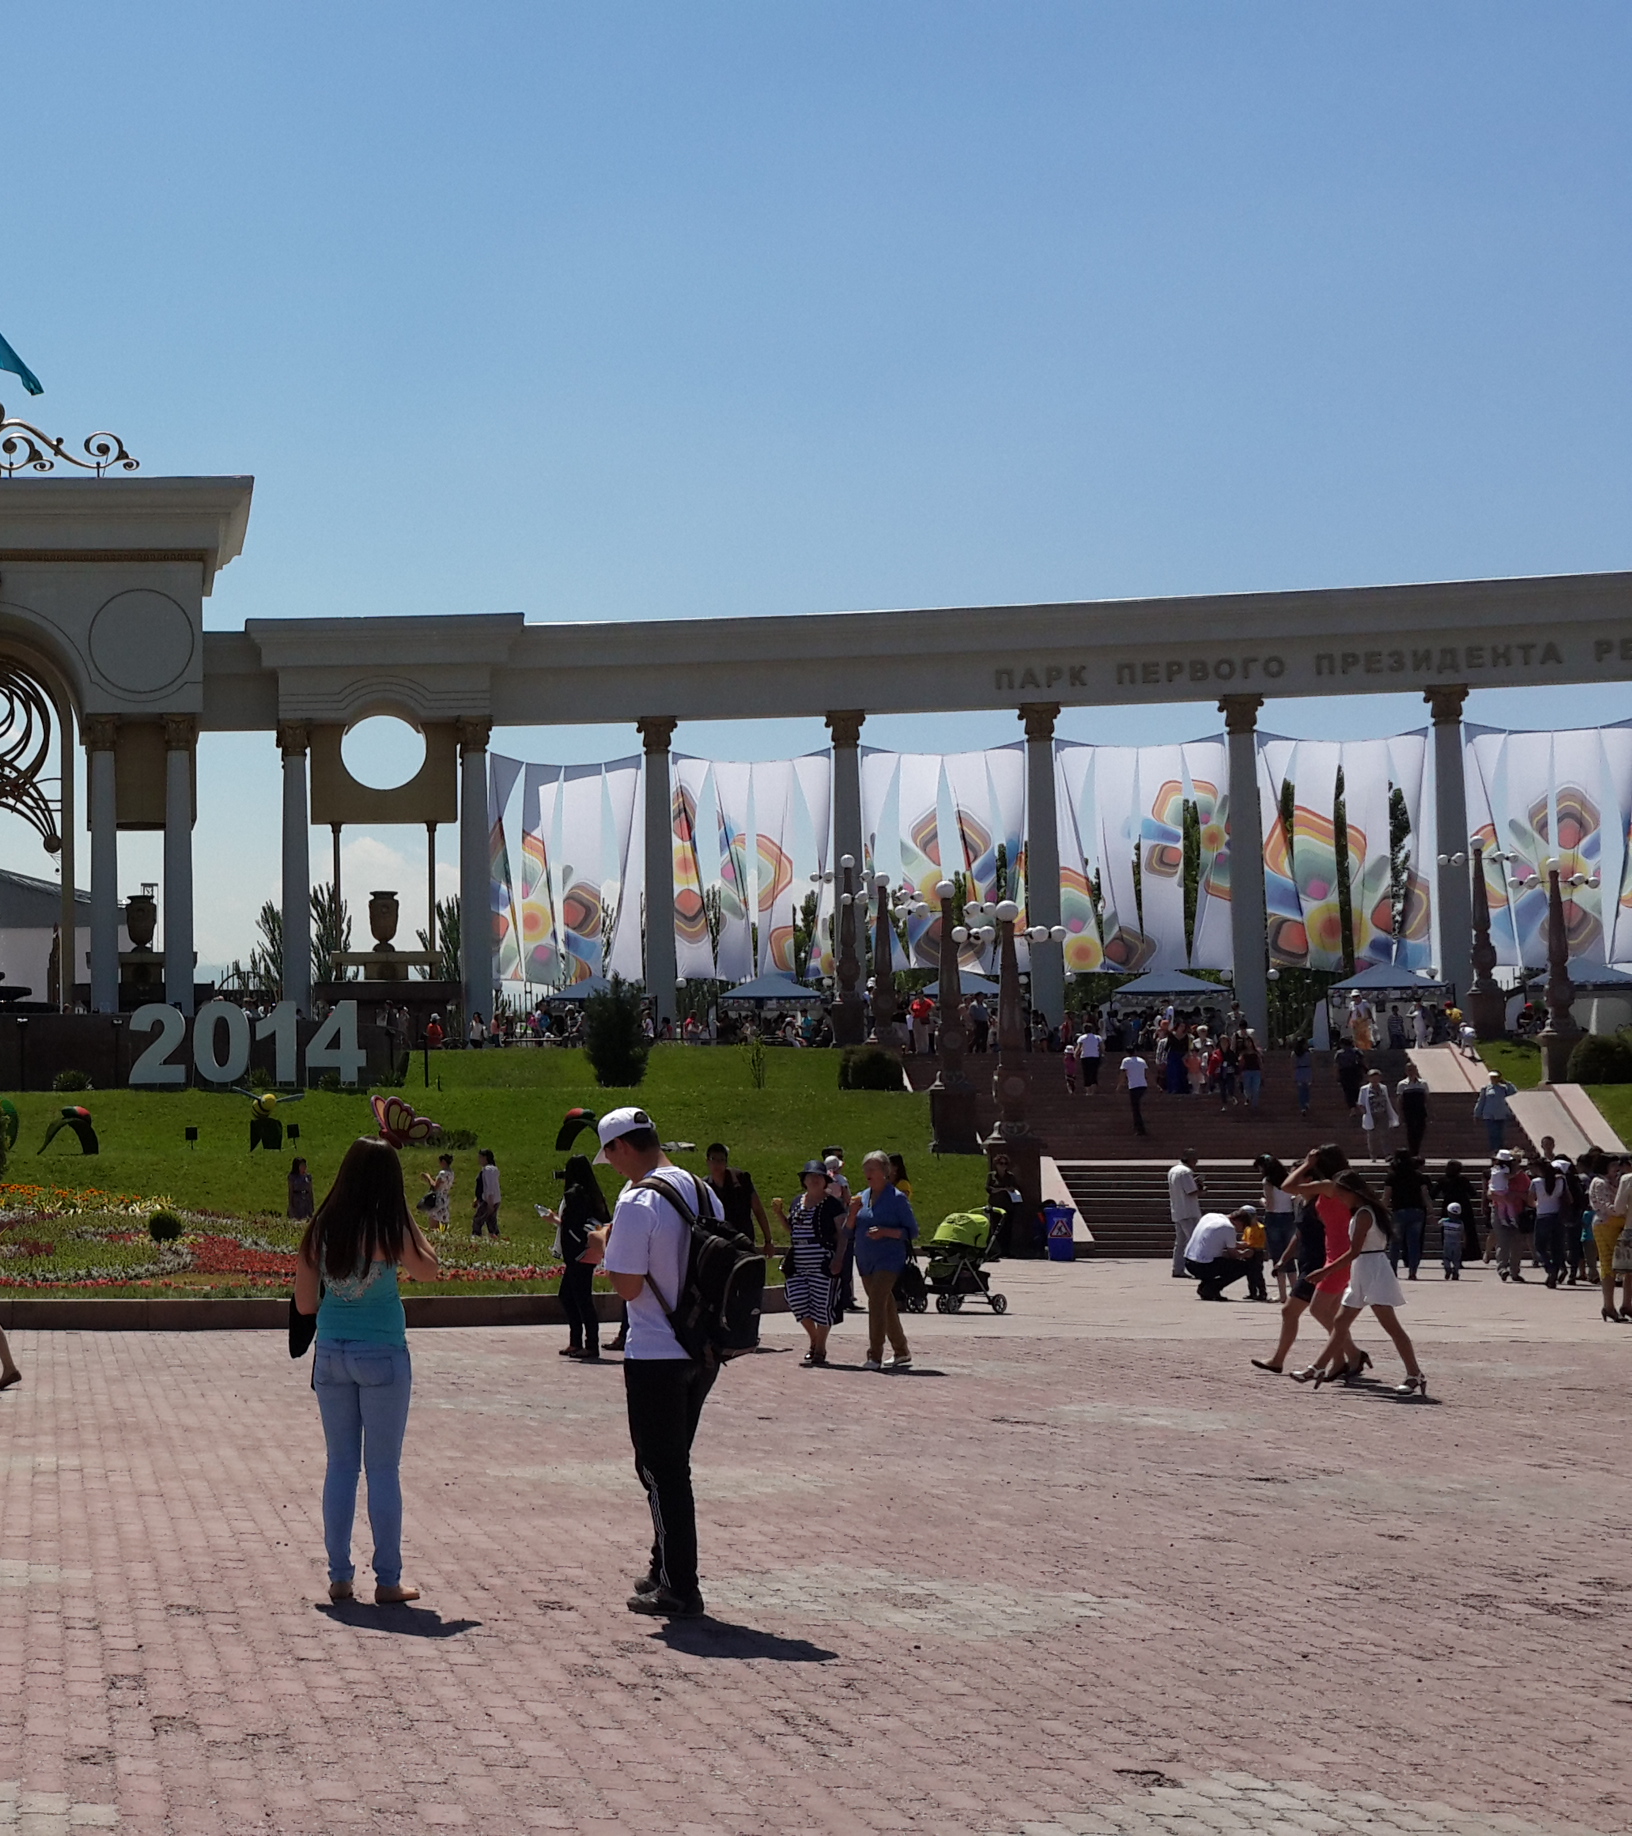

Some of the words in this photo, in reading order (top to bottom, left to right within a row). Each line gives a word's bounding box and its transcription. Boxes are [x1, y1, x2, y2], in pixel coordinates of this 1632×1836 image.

[995, 665, 1087, 690] ПАРК
[1117, 655, 1285, 686] ПЕРВОГО
[1315, 641, 1563, 675] ПРЕЗИДЕНТА
[129, 1000, 366, 1083] 2014
